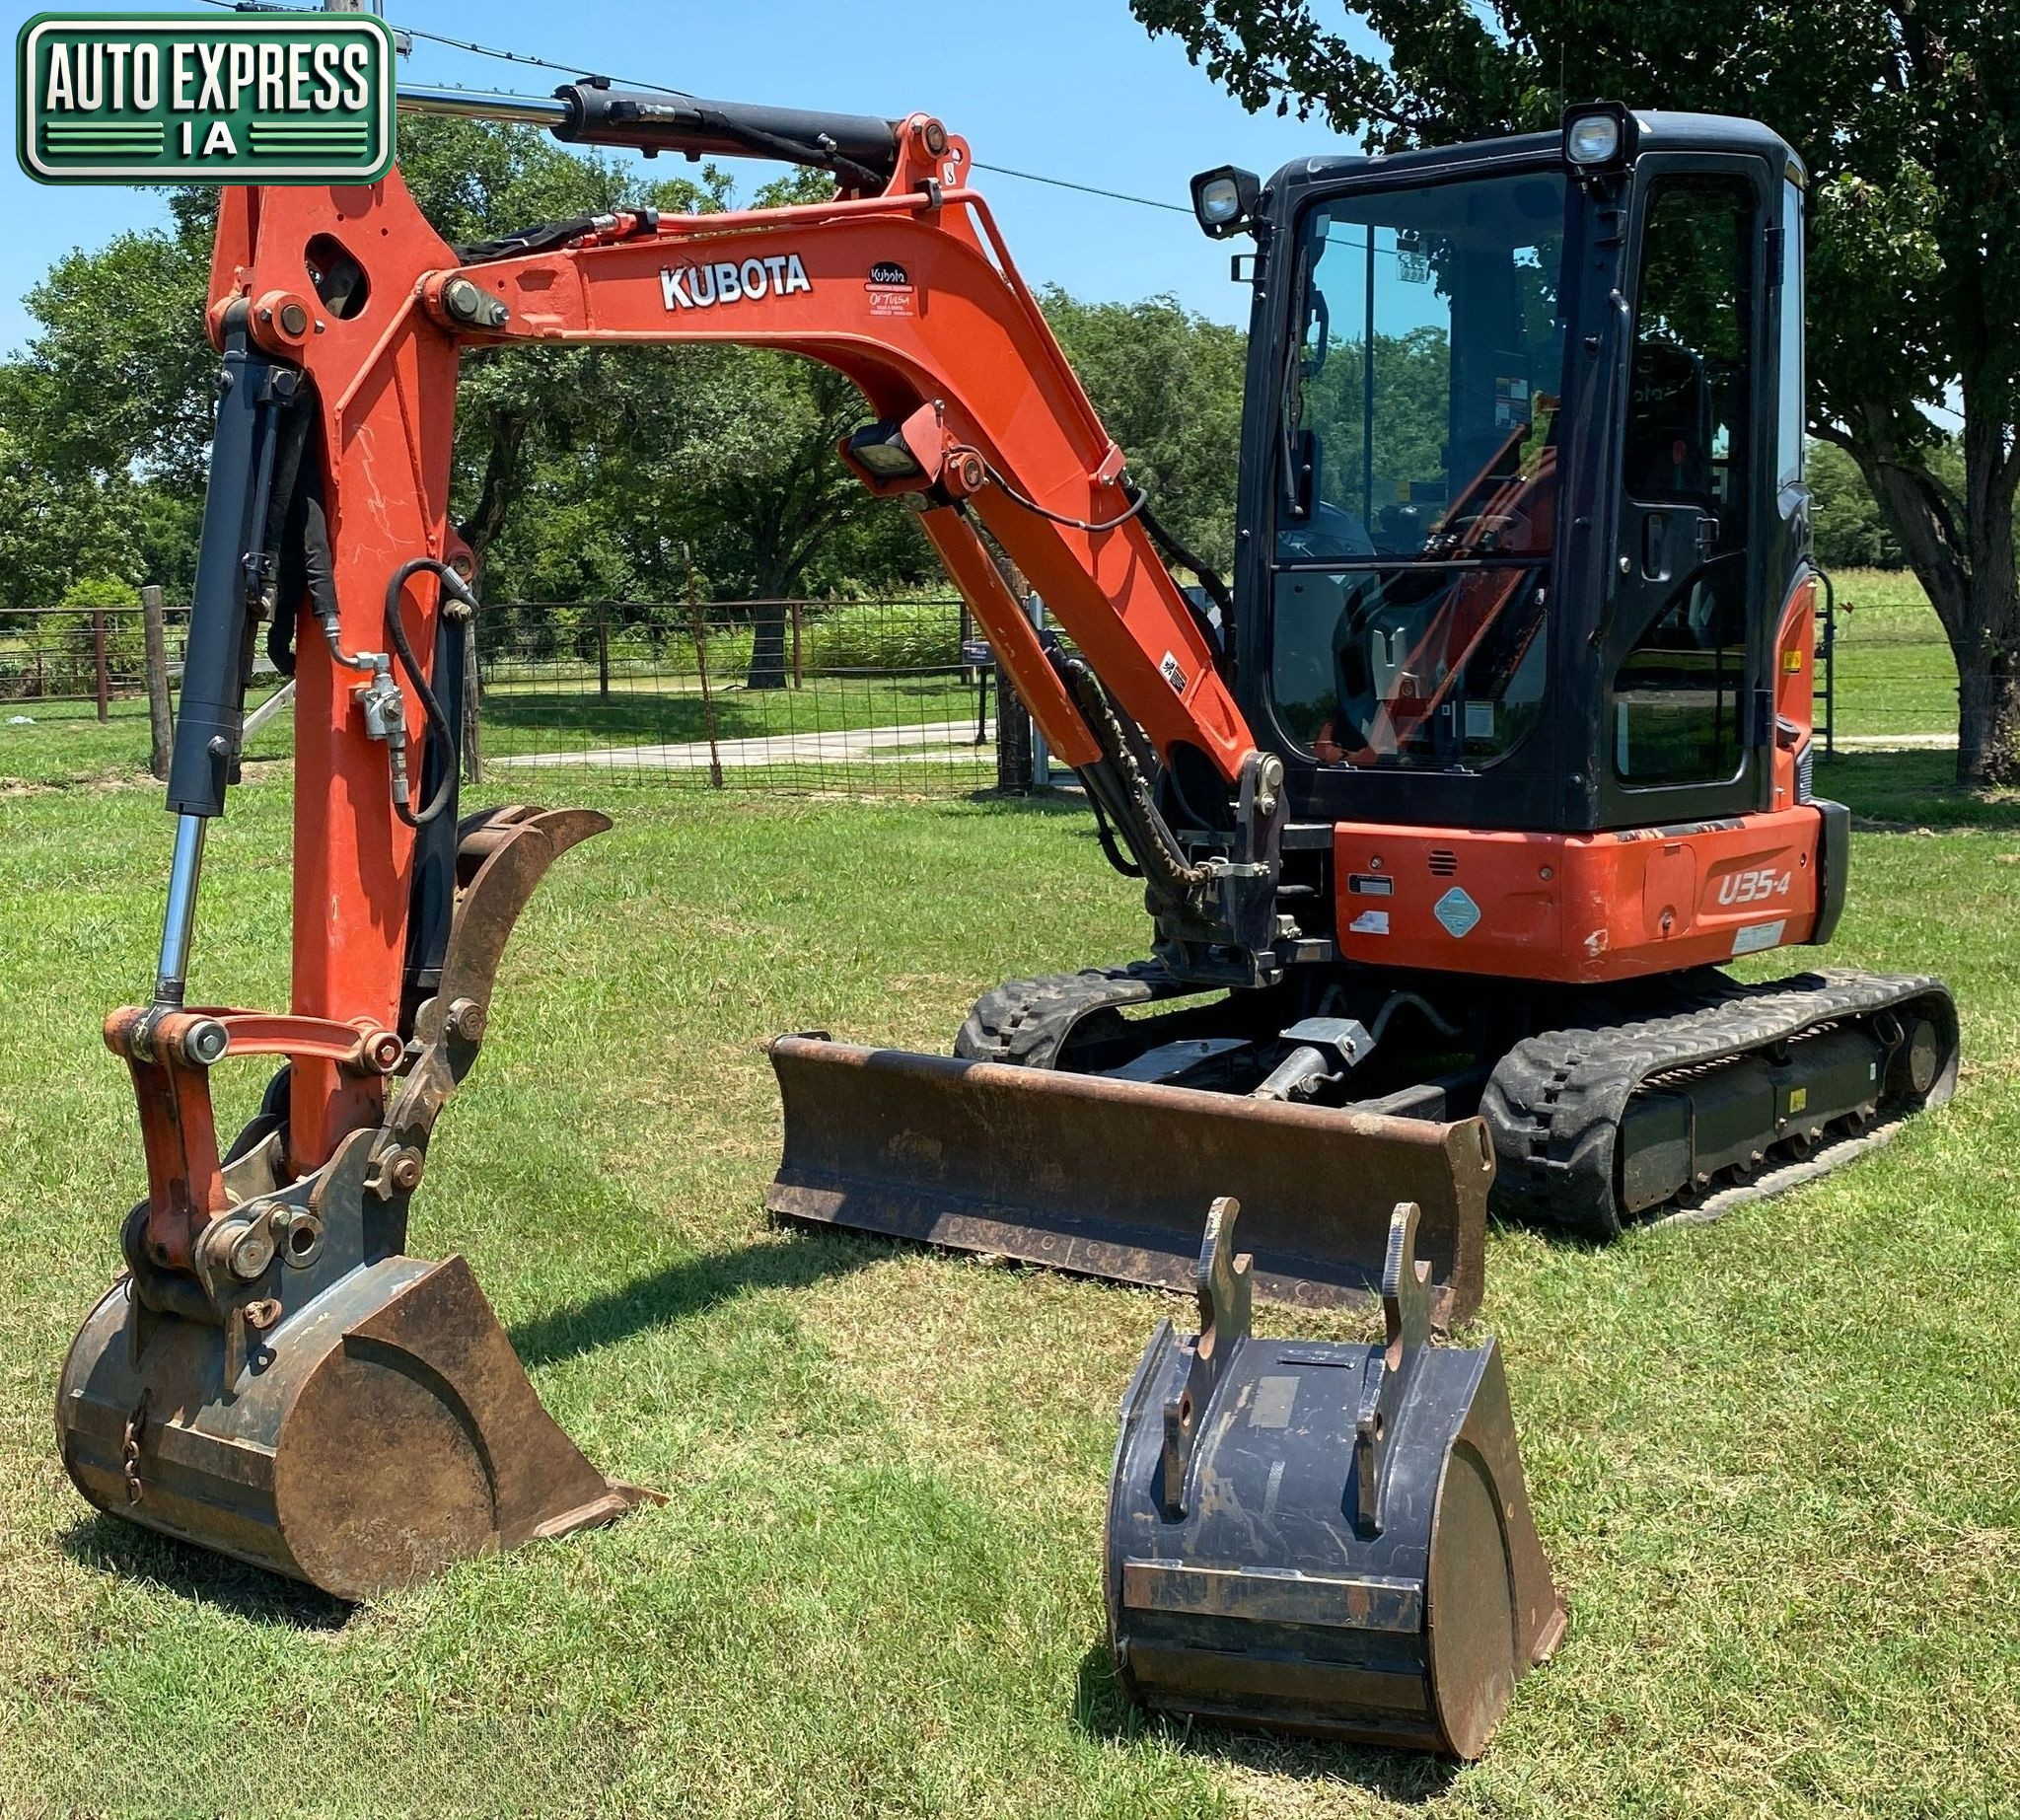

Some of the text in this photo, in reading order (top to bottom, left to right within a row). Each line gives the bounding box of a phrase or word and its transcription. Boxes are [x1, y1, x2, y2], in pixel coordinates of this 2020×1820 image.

[660, 254, 812, 311] KUBOTA
[871, 268, 905, 283] Kubota
[1718, 868, 1791, 906] U35-4
